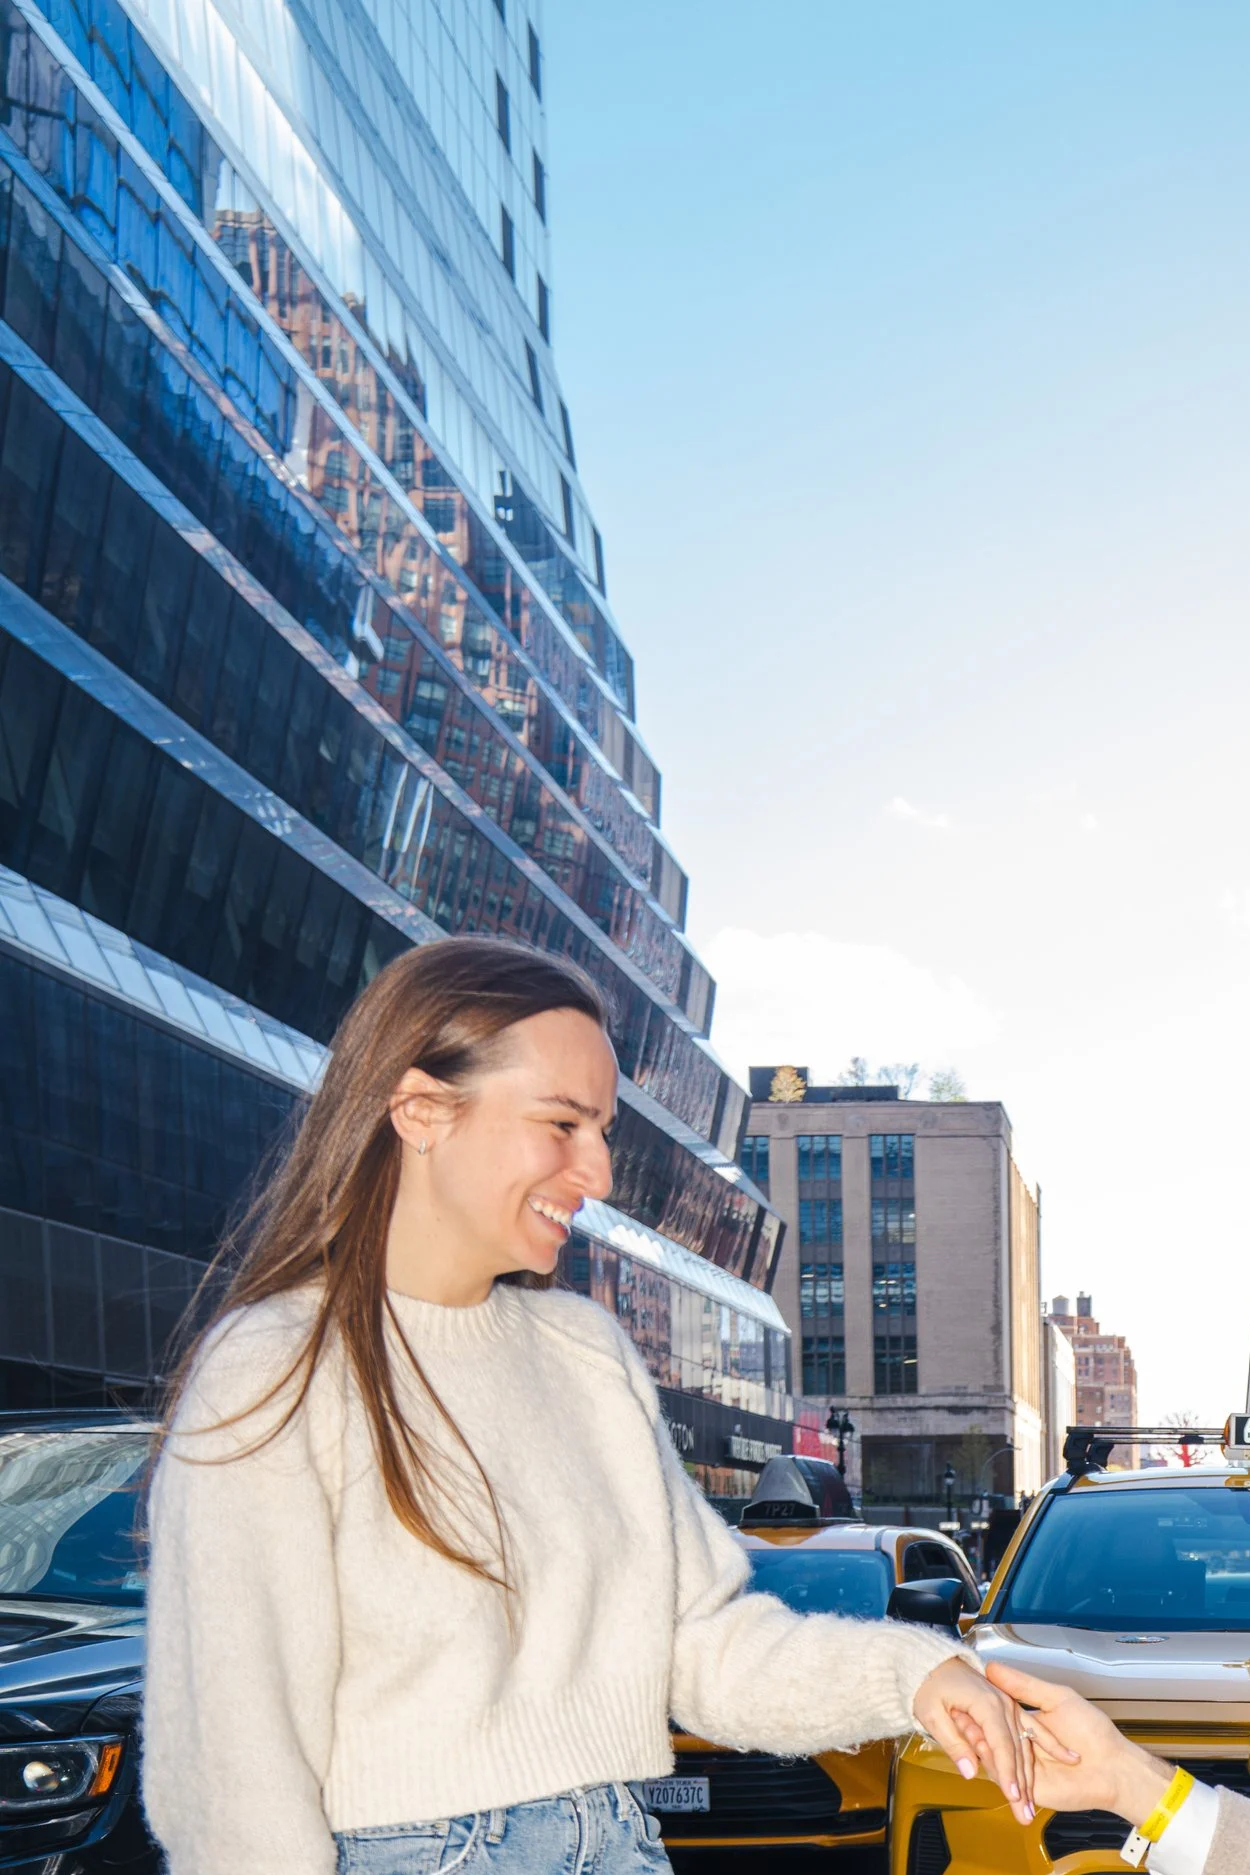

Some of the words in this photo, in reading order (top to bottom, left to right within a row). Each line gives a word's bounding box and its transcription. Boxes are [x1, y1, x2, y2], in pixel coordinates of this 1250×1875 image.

[670, 1422, 694, 1450] OTON
[764, 1502, 797, 1516] 7P27
[648, 1786, 704, 1804] Y207637C
